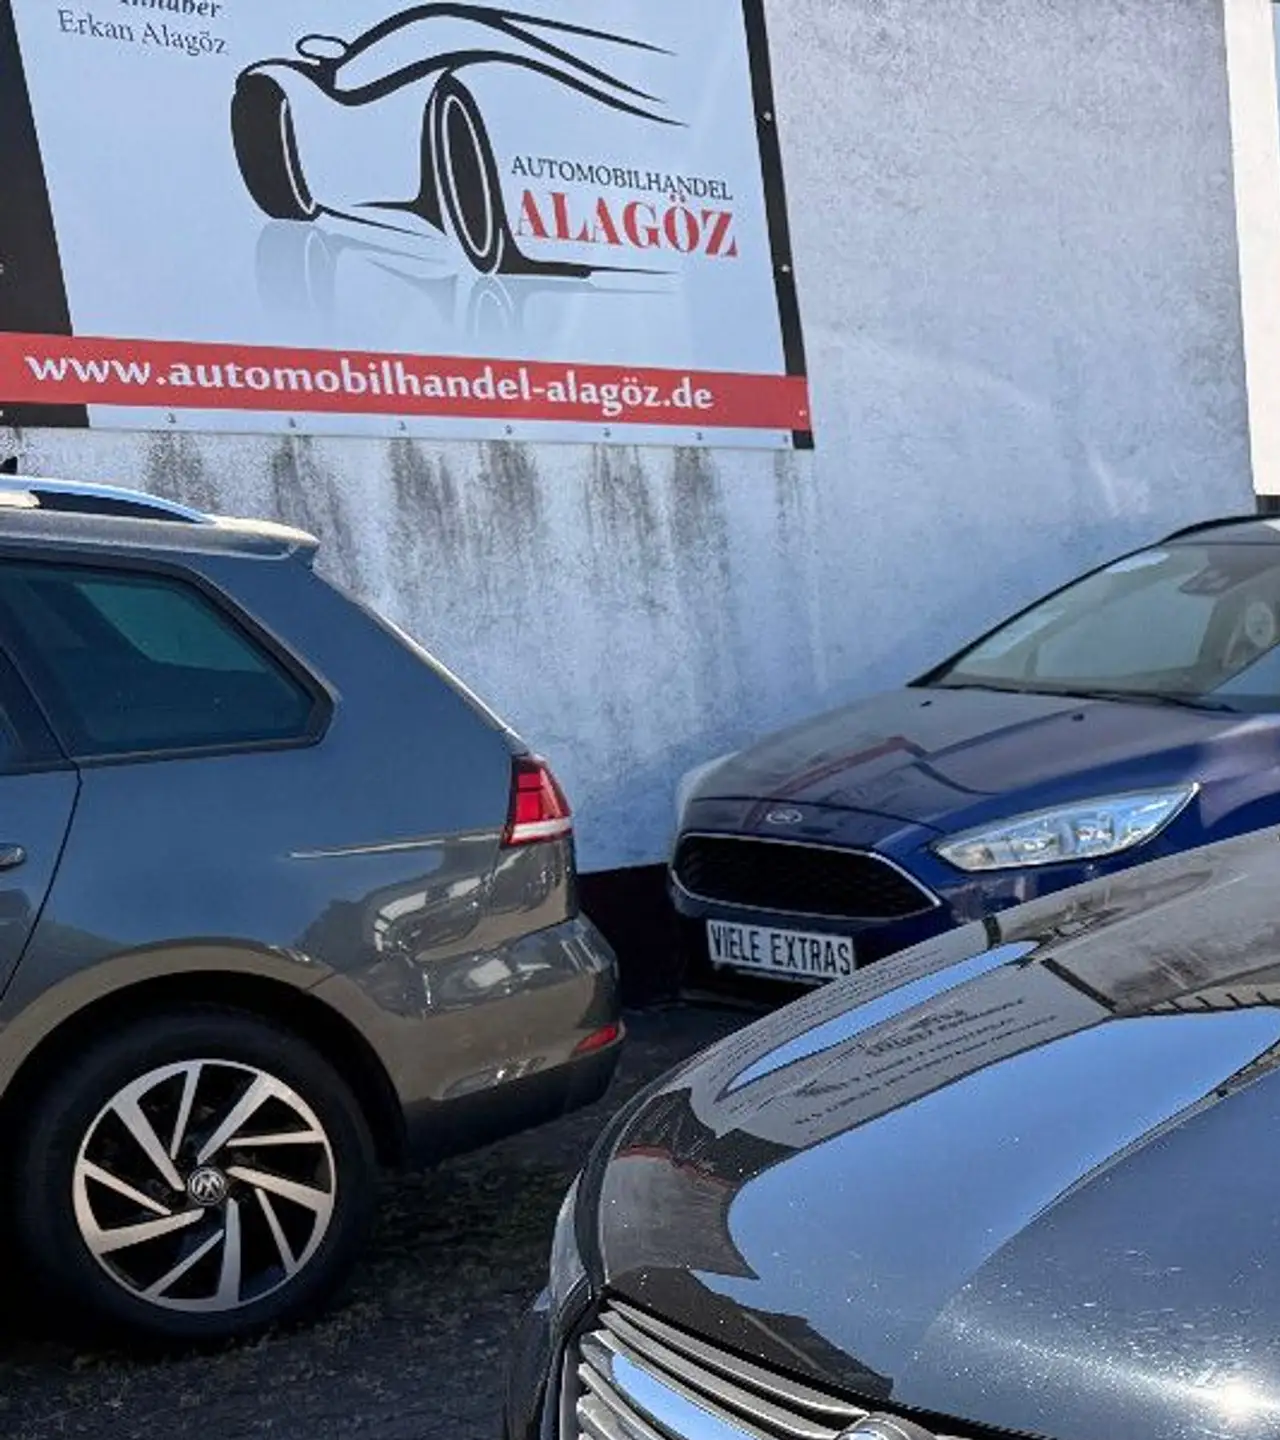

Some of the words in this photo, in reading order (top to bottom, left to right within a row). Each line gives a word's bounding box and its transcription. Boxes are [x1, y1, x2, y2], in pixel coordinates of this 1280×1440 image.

[58, 9, 134, 42] Erkan
[141, 22, 229, 56] Alagöz
[511, 156, 734, 200] AUTOMOBILHANDEL
[515, 189, 738, 257] ALAGÖZ
[24, 355, 714, 416] www.automobilhandel-alagöz.de
[710, 924, 762, 963] VIELE
[770, 933, 851, 975] EXTRAS
